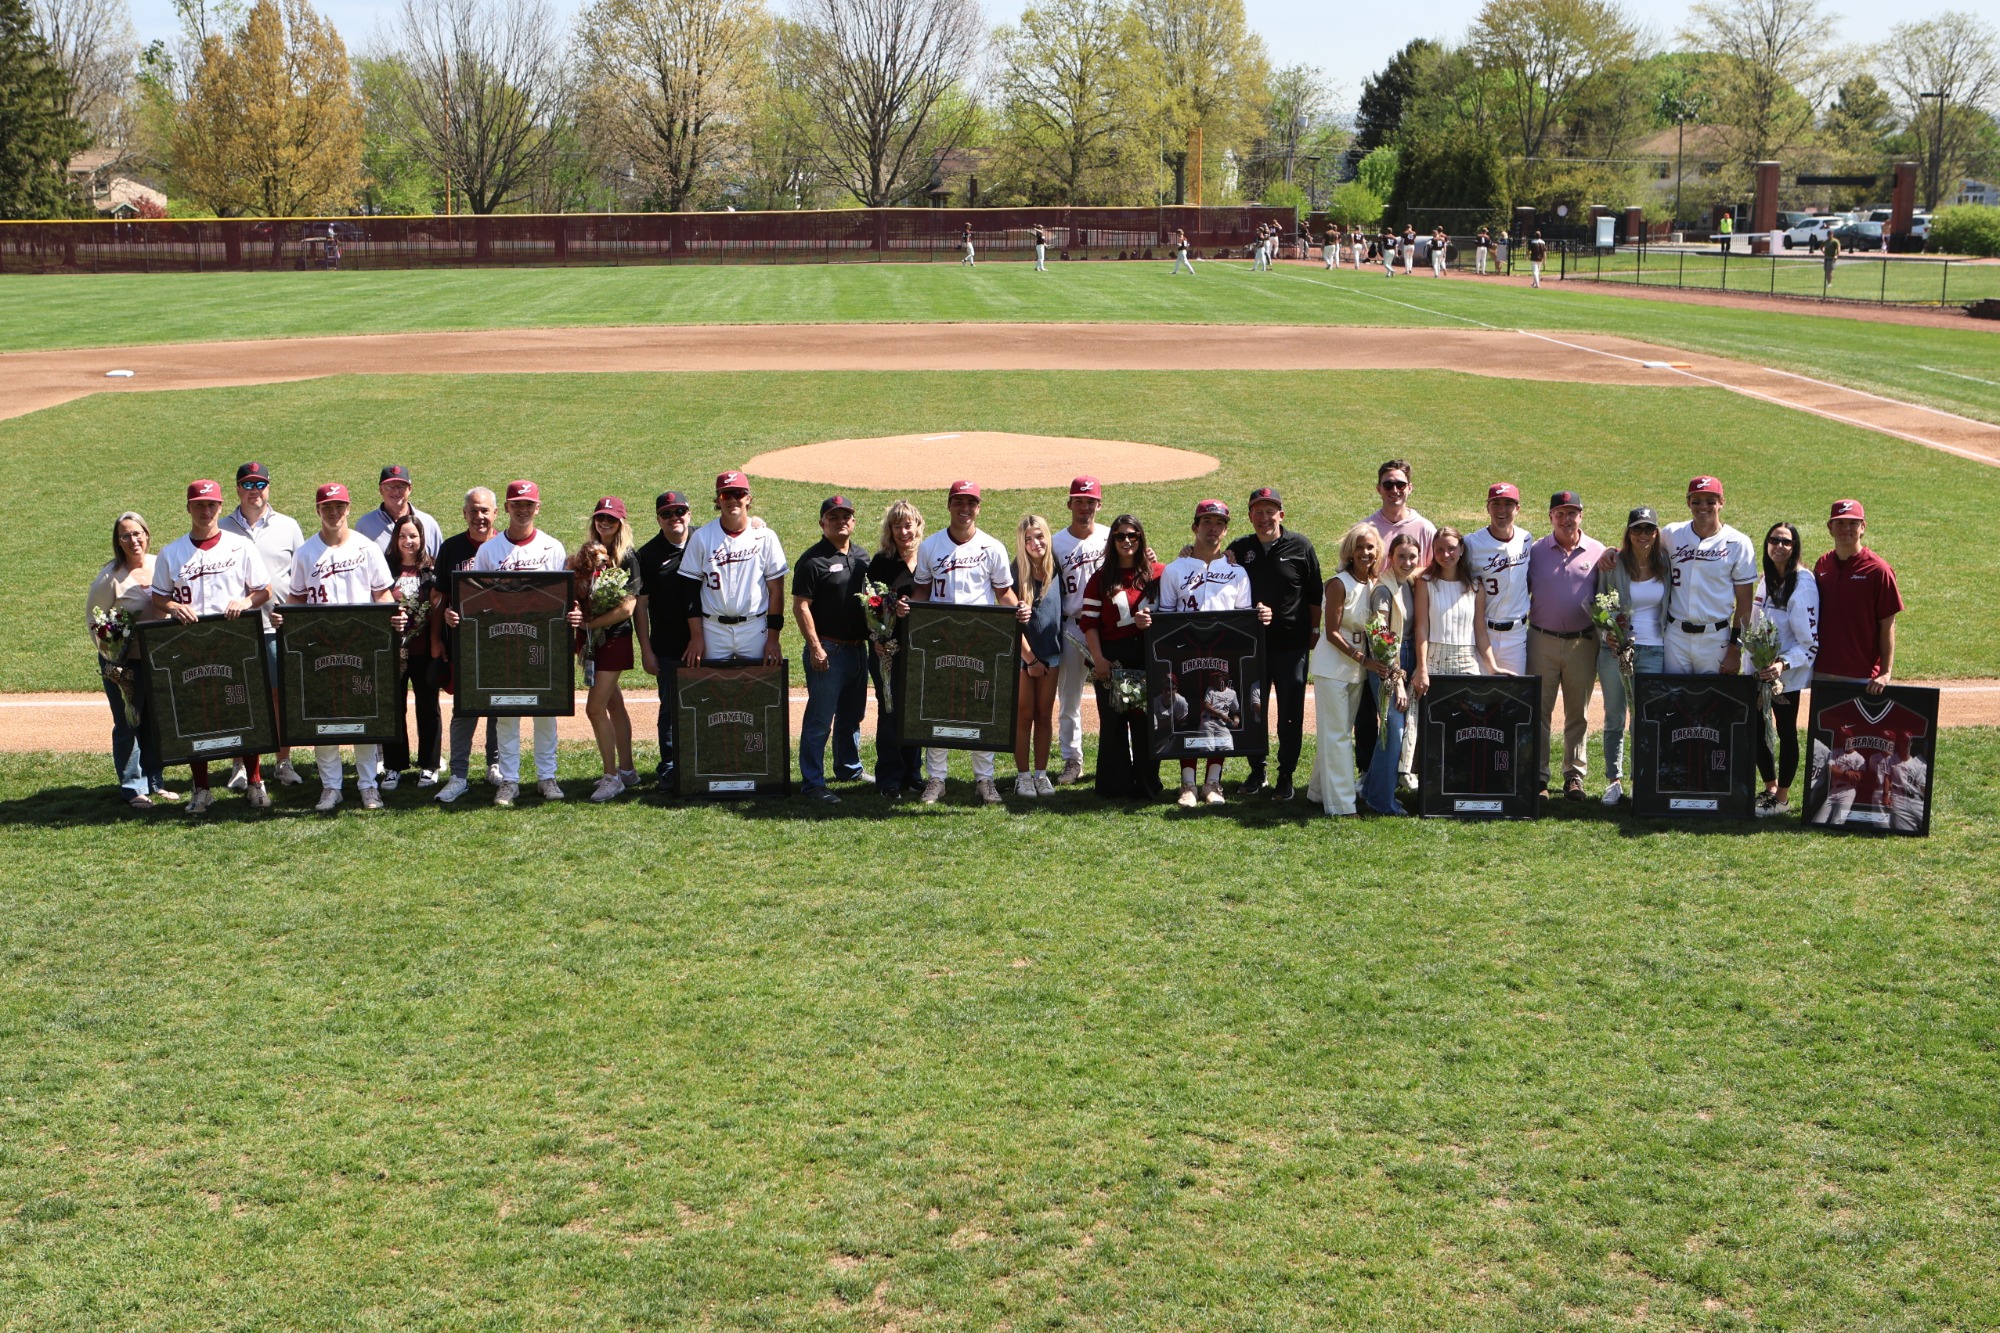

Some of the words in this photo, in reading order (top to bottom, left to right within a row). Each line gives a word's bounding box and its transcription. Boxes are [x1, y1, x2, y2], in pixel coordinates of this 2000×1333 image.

[200, 483, 214, 494] L
[724, 473, 738, 484] L
[959, 481, 974, 490] L
[1080, 481, 1094, 492] L
[1697, 478, 1711, 489] L
[326, 485, 341, 497] L
[517, 483, 532, 495] L
[1496, 484, 1510, 495] L
[605, 499, 613, 509] L
[1838, 501, 1854, 513] L
[495, 554, 549, 571] Leopards
[708, 544, 760, 566] Leopards
[933, 552, 988, 575] Leopards
[1671, 544, 1731, 564] Leopards
[178, 557, 237, 580] Leopards
[311, 554, 367, 578] Leopards
[934, 578, 946, 598] 17
[1180, 570, 1238, 591] Leopards
[173, 585, 192, 605] 39
[308, 584, 329, 604] 34
[488, 622, 538, 640] LAFAYETTE
[314, 653, 364, 672] LAFAYETTE
[528, 645, 545, 666] 31
[935, 654, 985, 674] LAFAYETTE
[1181, 656, 1229, 675] LAFAYETTE
[182, 664, 233, 685] LAFAYETTE
[224, 684, 246, 705] 39
[352, 675, 373, 695] 34
[974, 679, 990, 700] 17
[707, 710, 754, 728] LAFAYETTE
[744, 732, 764, 753] 23
[1456, 726, 1505, 744] LAFAYETTE
[1671, 726, 1720, 744] LAFAYETTE
[1844, 735, 1896, 756] LAFAYETTE
[1494, 750, 1509, 771] 13
[1711, 749, 1726, 771] 12
